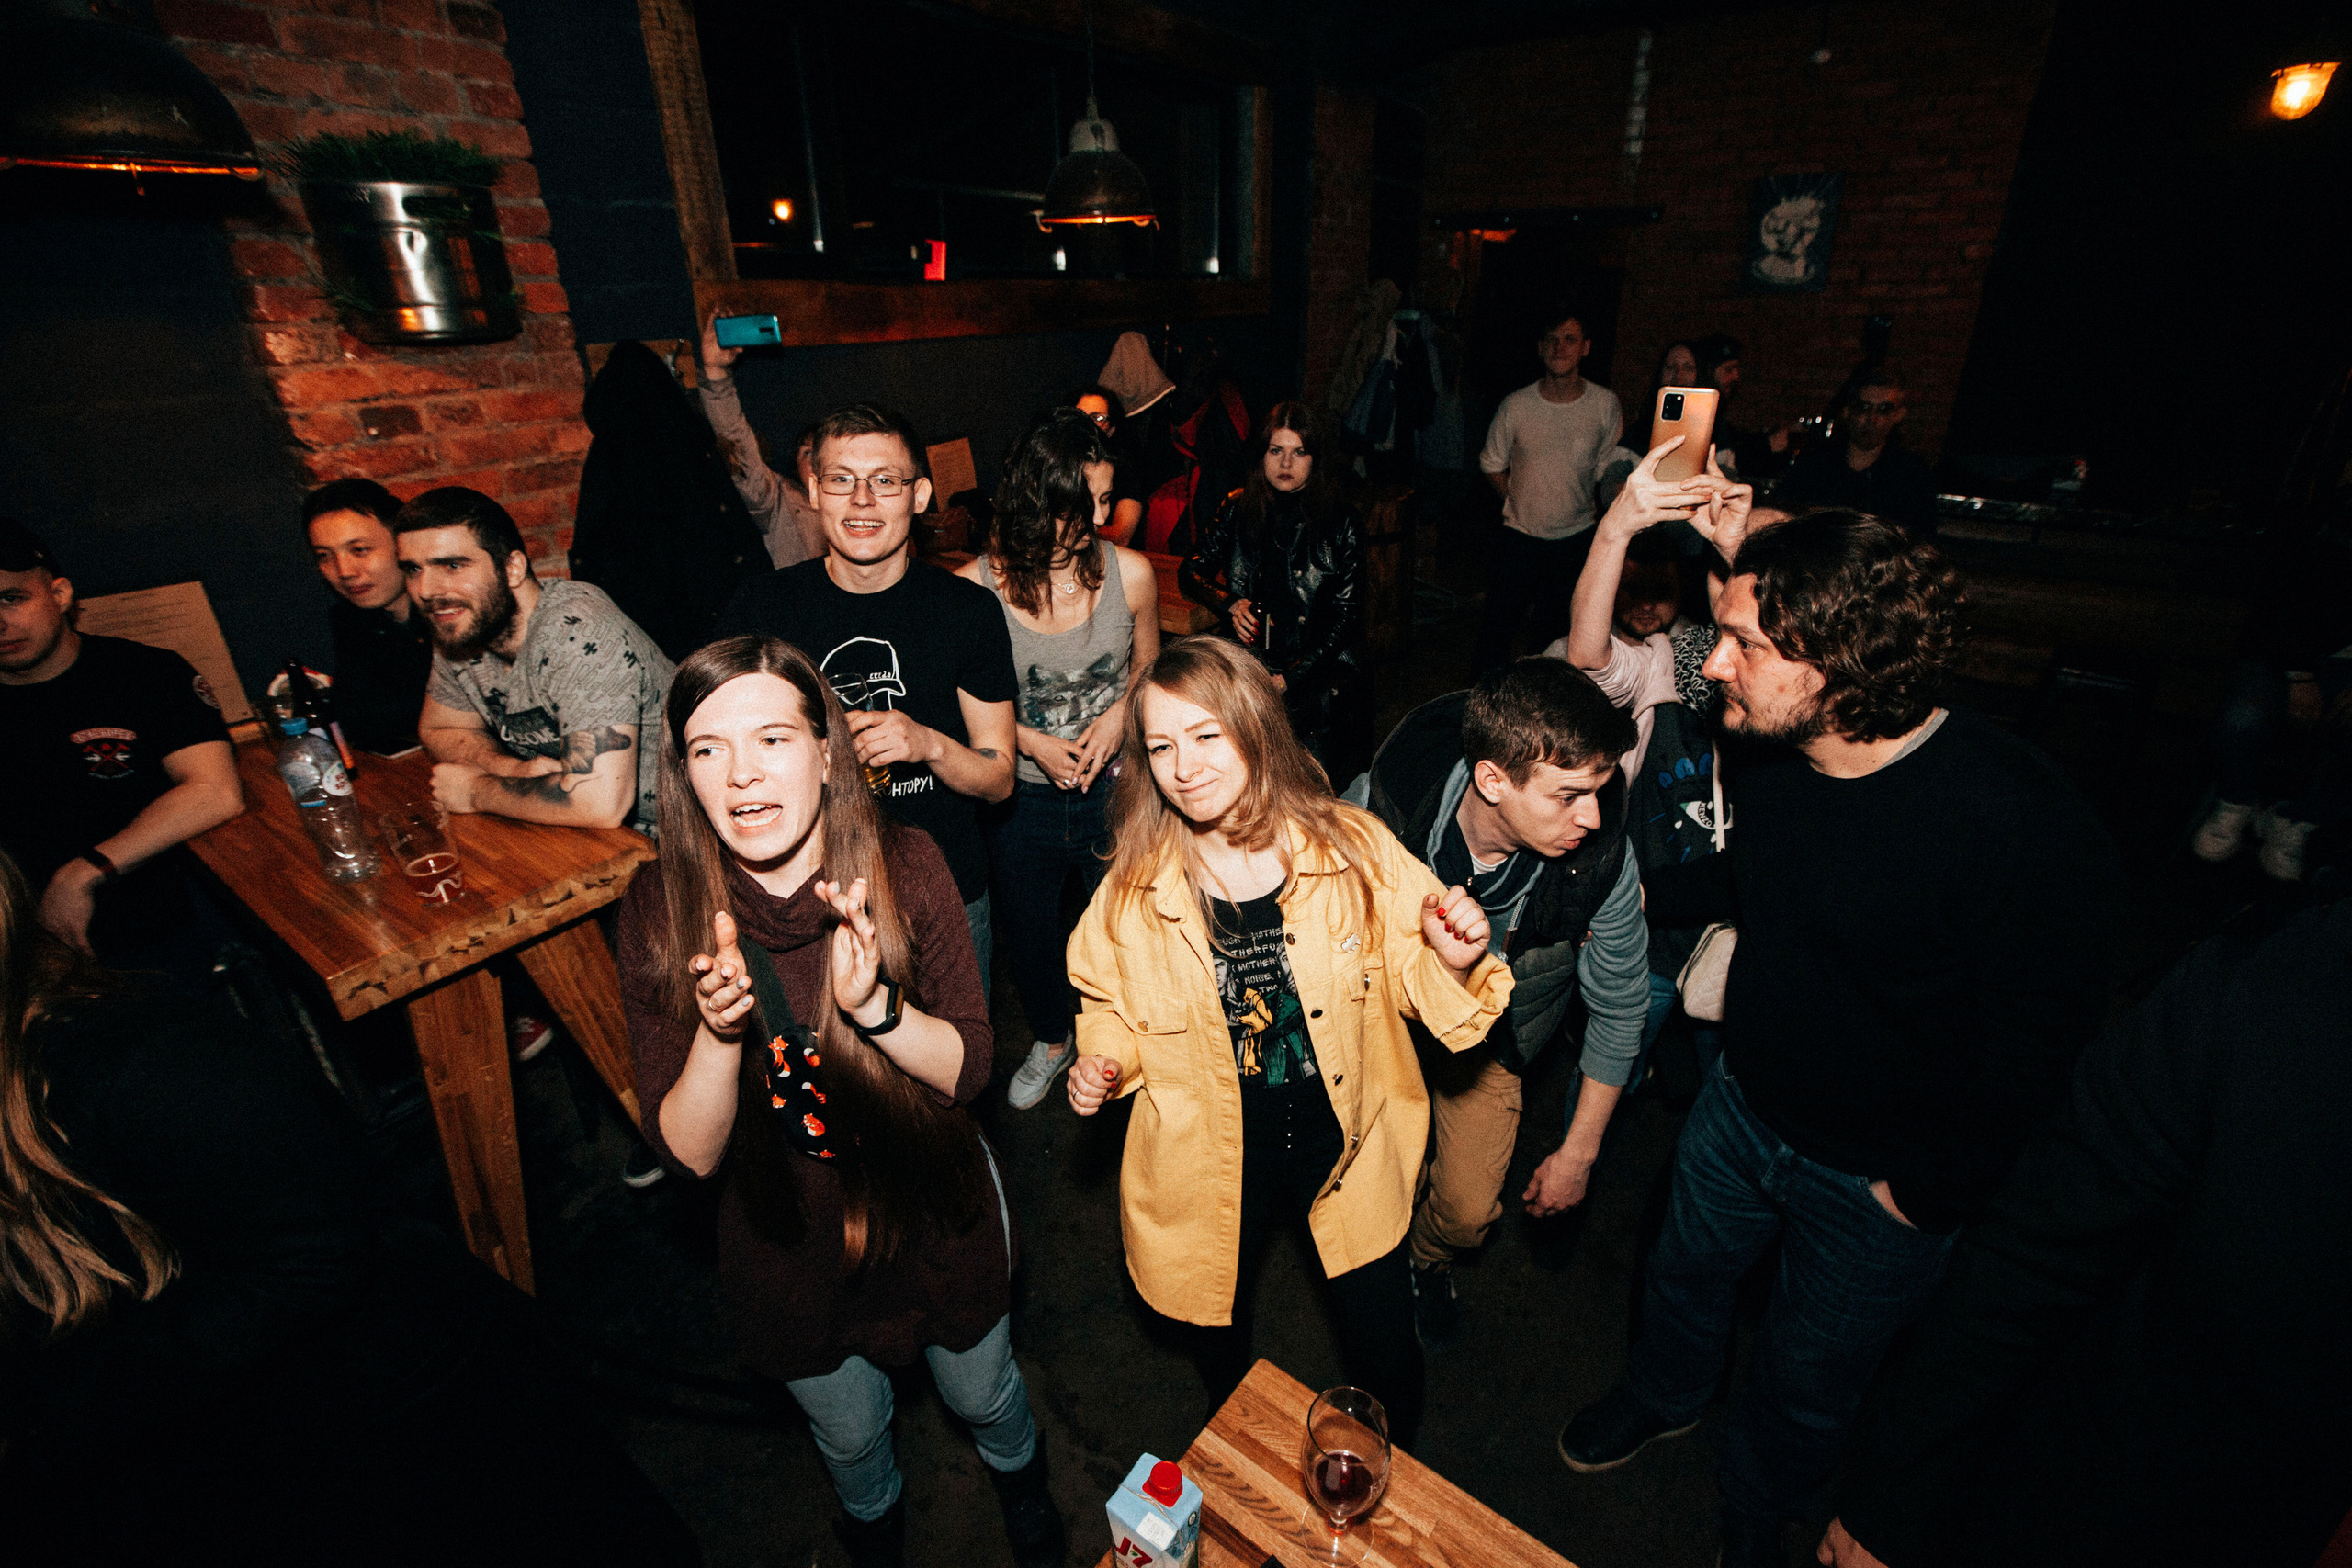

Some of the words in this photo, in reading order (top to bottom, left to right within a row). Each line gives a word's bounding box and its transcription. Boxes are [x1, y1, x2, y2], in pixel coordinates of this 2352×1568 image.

[1698, 800, 1713, 828] KENZO
[1250, 927, 1283, 939] MOTHE
[1231, 943, 1276, 956] THERFU
[1238, 956, 1278, 972] MOTHER
[1114, 1536, 1153, 1568] J7
